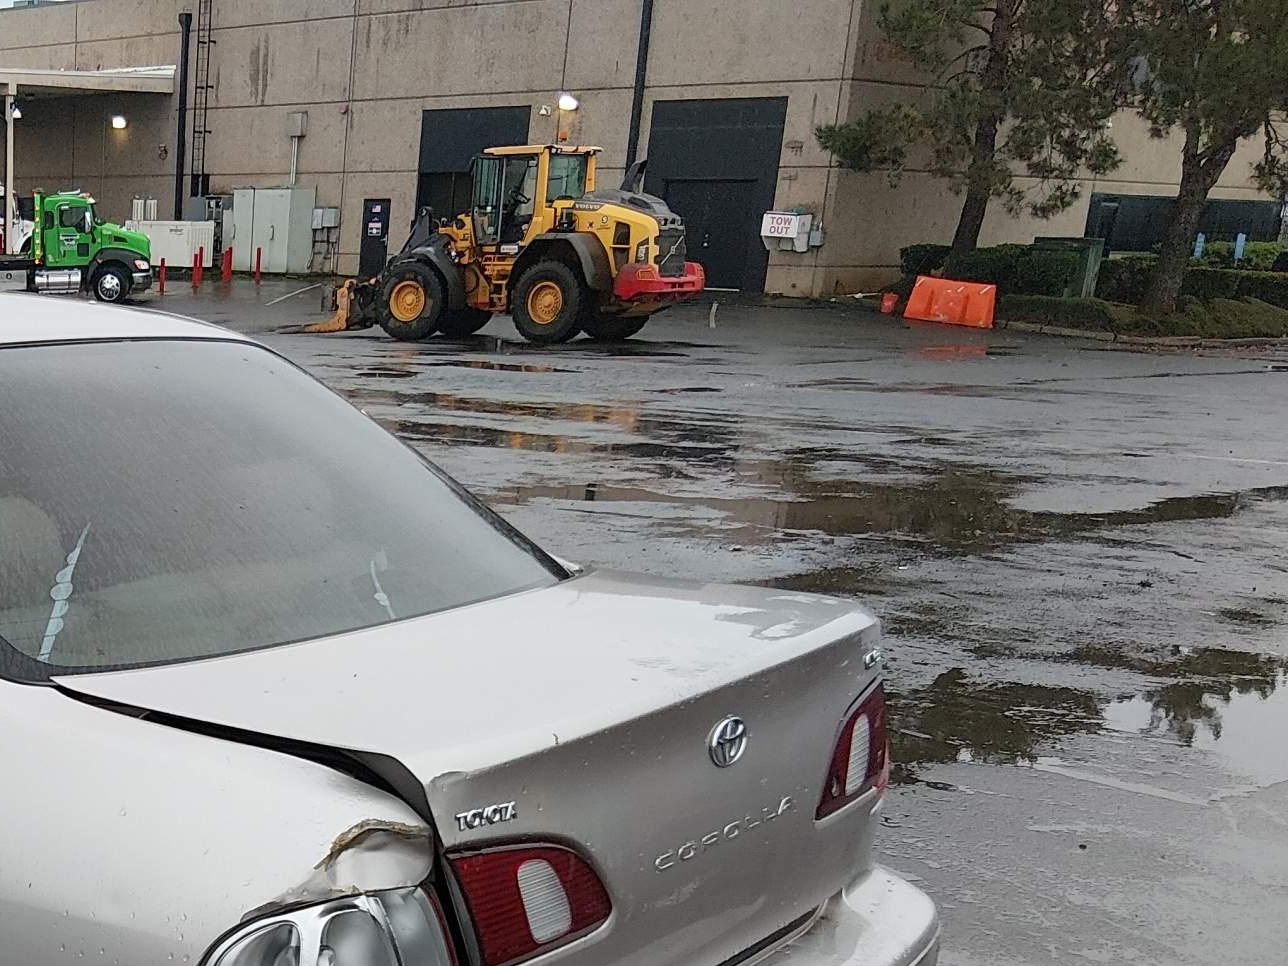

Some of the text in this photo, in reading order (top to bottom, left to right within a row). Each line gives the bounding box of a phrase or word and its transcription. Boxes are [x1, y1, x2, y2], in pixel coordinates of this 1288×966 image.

[769, 226, 790, 235] OUT
[770, 216, 793, 226] TOW
[455, 801, 517, 832] TOYOTA
[655, 796, 792, 871] COROLLA
